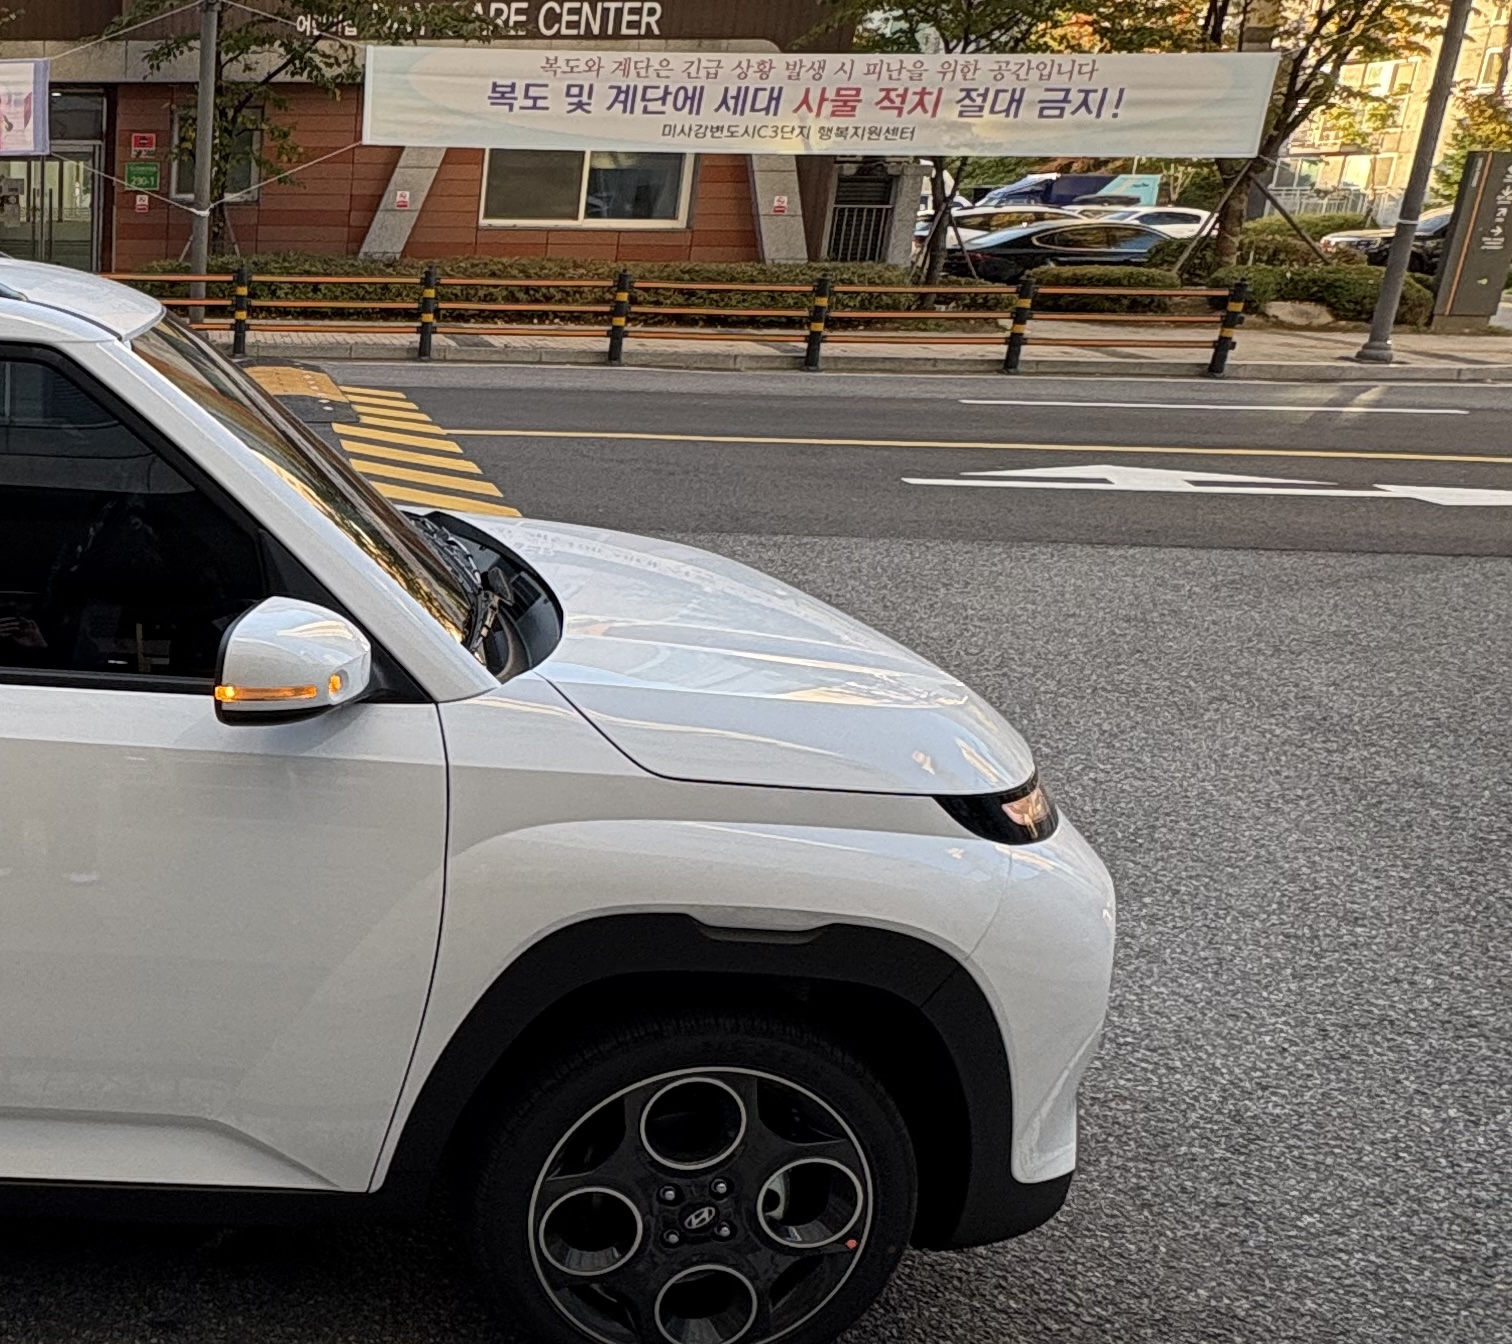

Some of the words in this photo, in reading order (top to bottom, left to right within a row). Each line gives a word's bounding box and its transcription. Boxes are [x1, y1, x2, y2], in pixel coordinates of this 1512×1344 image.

[537, 0, 664, 37] CENTER
[540, 55, 606, 79] 복도와
[611, 56, 675, 80] 계단은
[681, 57, 724, 81] 긴급
[731, 58, 777, 82] 상황
[784, 58, 827, 82] 발생
[833, 58, 856, 82] 시
[863, 59, 930, 83] 피난을
[936, 59, 981, 83] 위한
[989, 58, 1100, 83] 공간입니다
[487, 81, 550, 113] 복도
[565, 83, 595, 114] 및
[606, 83, 706, 116] 계단에
[713, 85, 785, 117] 세대
[791, 86, 863, 118] 사물
[874, 86, 944, 119] 적치
[954, 87, 1027, 119] 절대
[1037, 86, 1127, 120] 금지!
[660, 122, 812, 141] 미사강변도시C3단지
[816, 125, 917, 143] 행복지원센터
